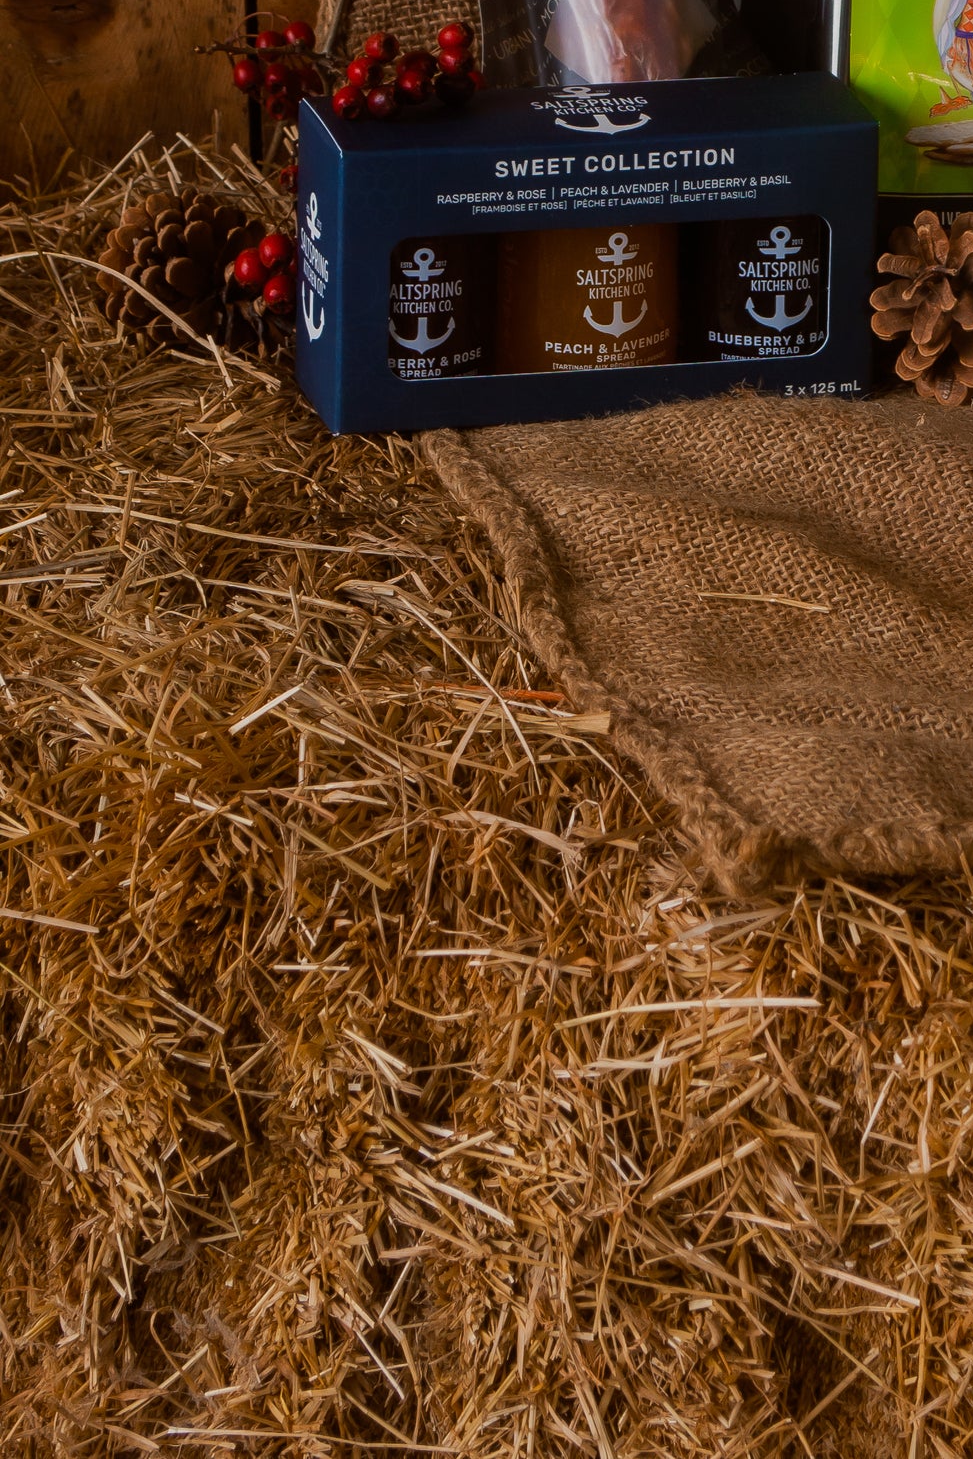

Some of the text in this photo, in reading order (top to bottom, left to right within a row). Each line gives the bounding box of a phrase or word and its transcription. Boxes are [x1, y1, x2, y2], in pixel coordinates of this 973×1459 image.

[530, 96, 648, 110] SALTSPRING
[553, 106, 615, 116] KITCHEN
[495, 147, 736, 179] SWEET COLLECTION
[436, 173, 792, 205] RASPBERRY & ROSE PEACH & LAVENDER BLUEBERRY & BASIL
[528, 203, 540, 211] ET
[607, 197, 618, 207] ET
[706, 191, 718, 201] ET
[576, 262, 654, 286] SALTSPRING
[738, 258, 819, 278] SALTSPRING
[389, 280, 463, 300] ALTSPRING
[588, 282, 647, 300] KITCHEN CO.
[750, 277, 811, 292] KITCHEN CO.
[393, 299, 454, 314] KITCHEN CO.
[544, 328, 671, 354] PEACH & LAVENDER
[708, 331, 805, 347] BLUEBERRY &
[387, 347, 482, 369] BERRY & ROSE
[596, 351, 636, 363] SPREAD
[758, 346, 800, 356] SPREAD
[400, 368, 442, 378] SPREAD
[784, 384, 794, 396] 3
[810, 381, 836, 394] 125
[840, 379, 862, 392] mL
